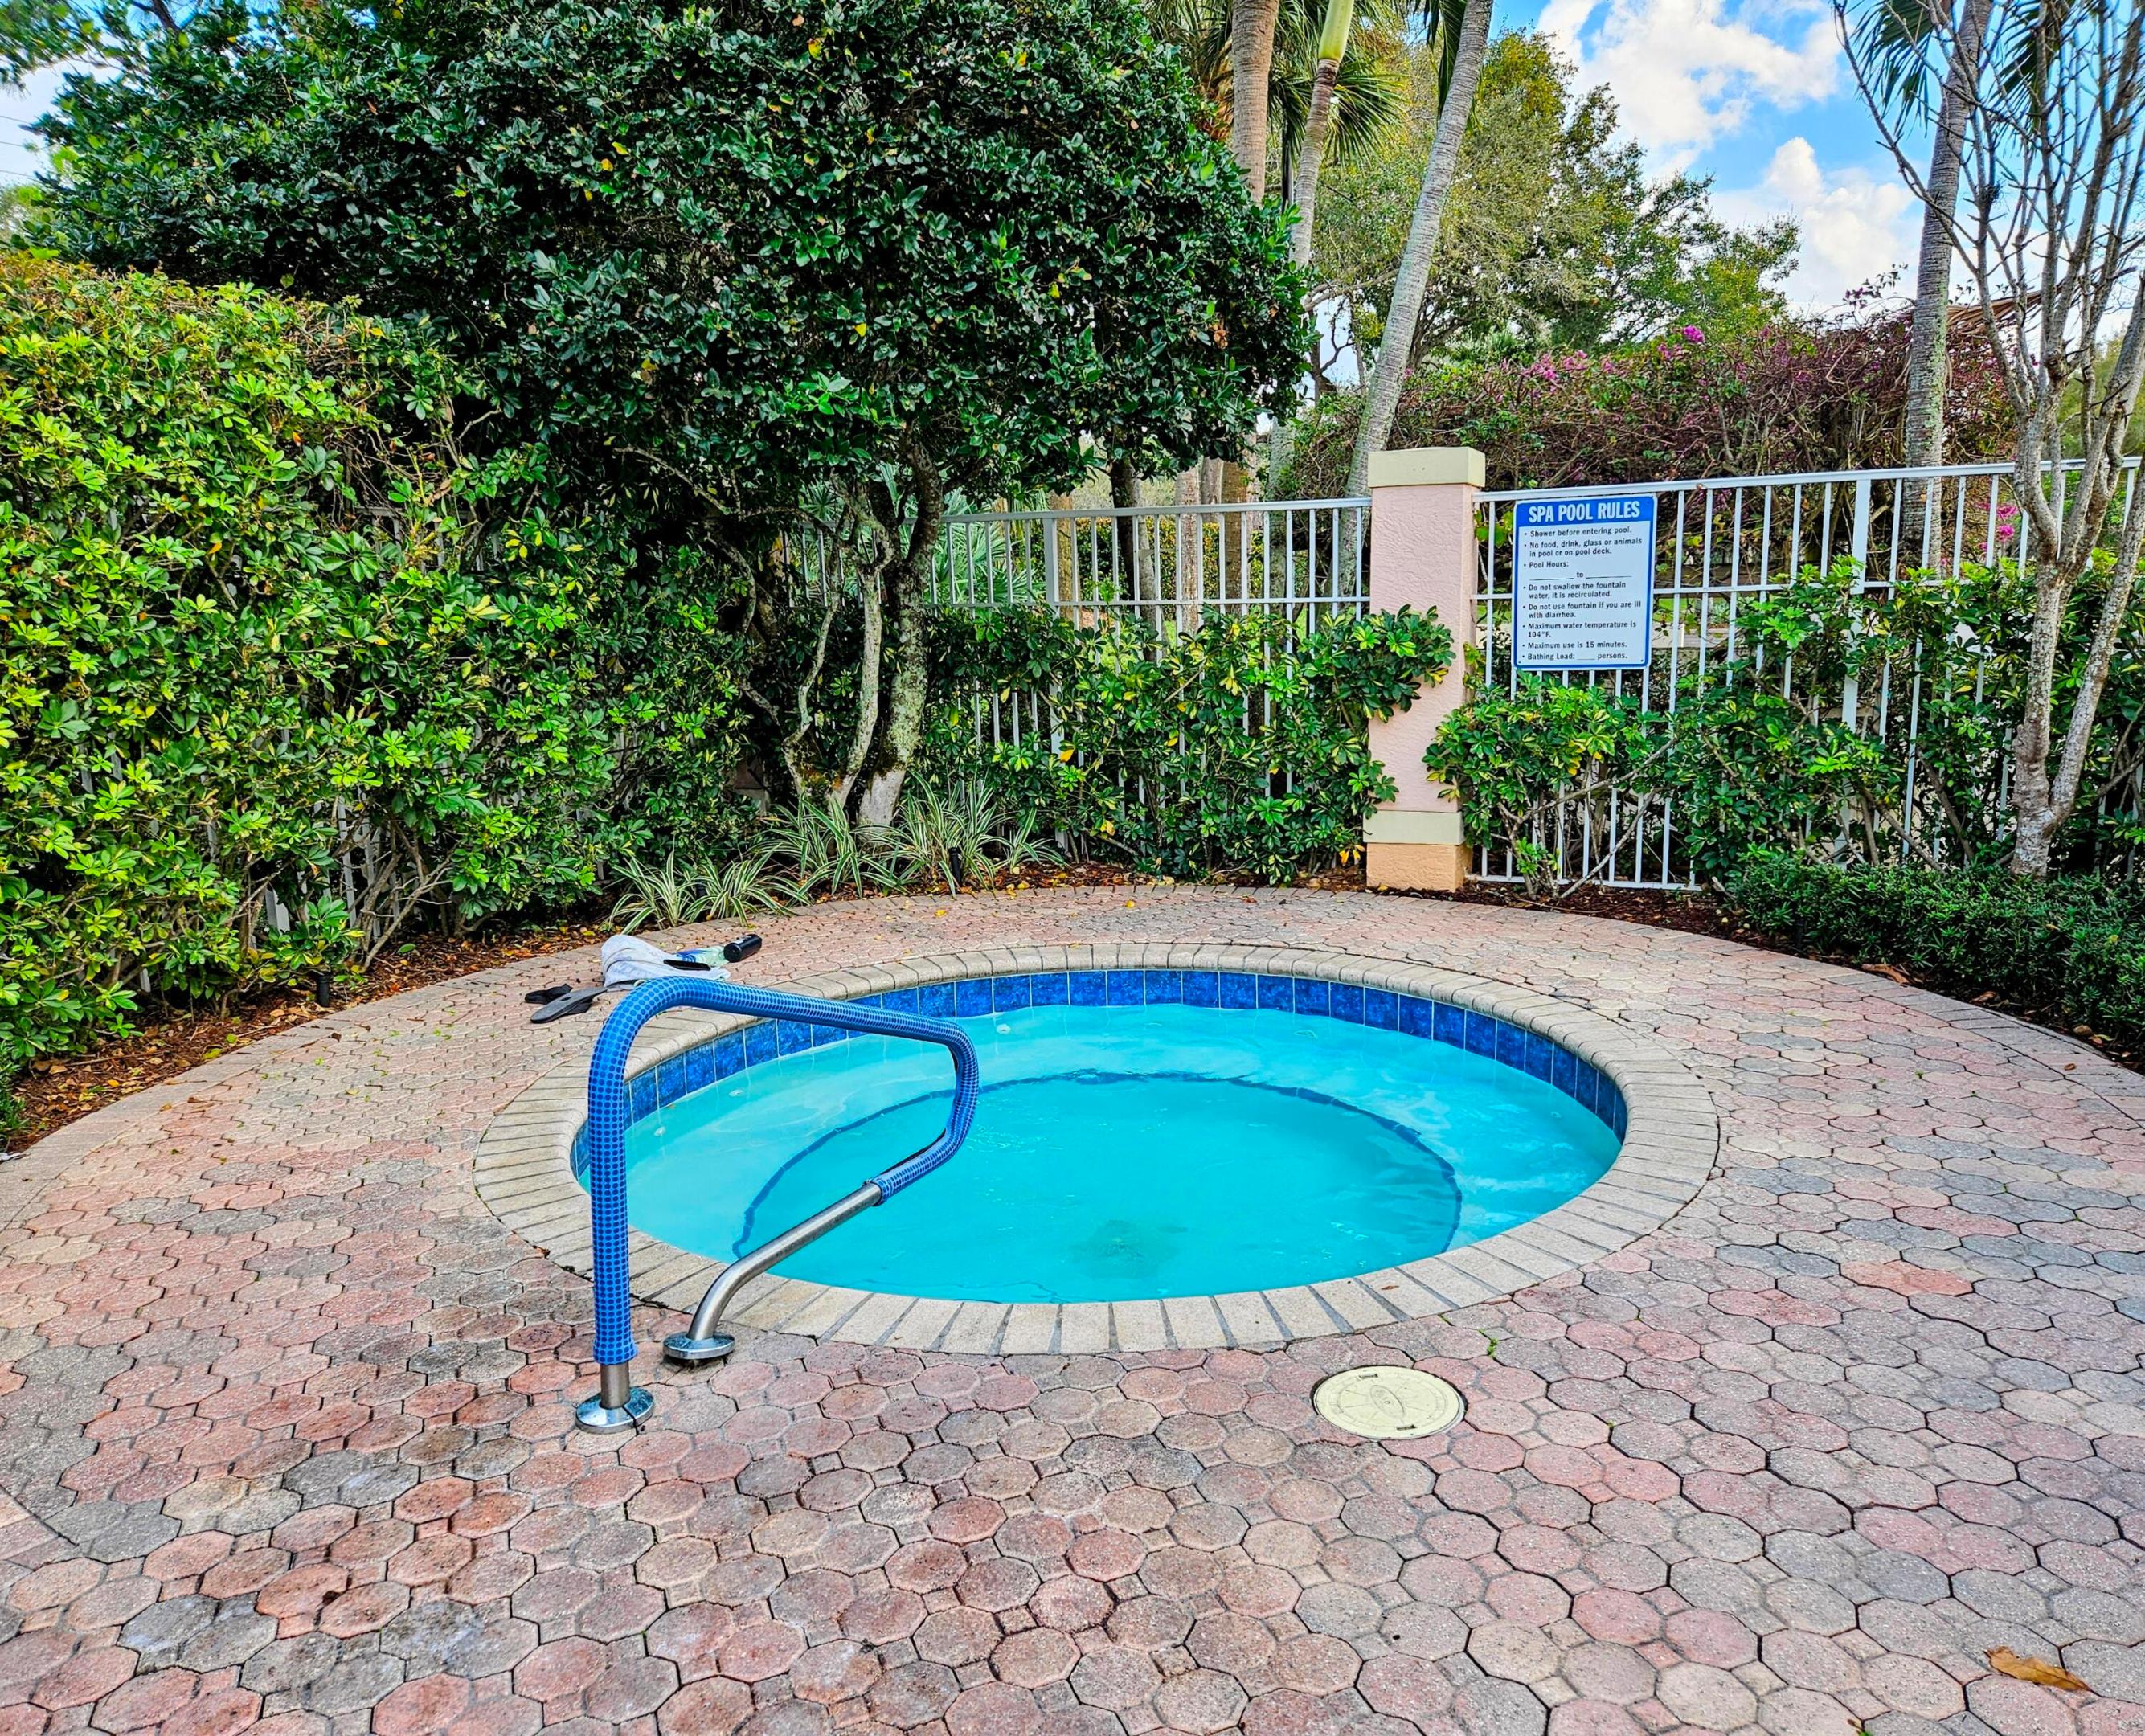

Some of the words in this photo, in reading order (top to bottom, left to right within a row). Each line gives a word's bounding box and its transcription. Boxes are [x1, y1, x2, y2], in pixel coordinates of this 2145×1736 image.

[1529, 506, 1553, 522] SPA
[1558, 504, 1593, 521] POOL
[1598, 501, 1640, 519] RULES
[1585, 621, 1627, 629] temperature
